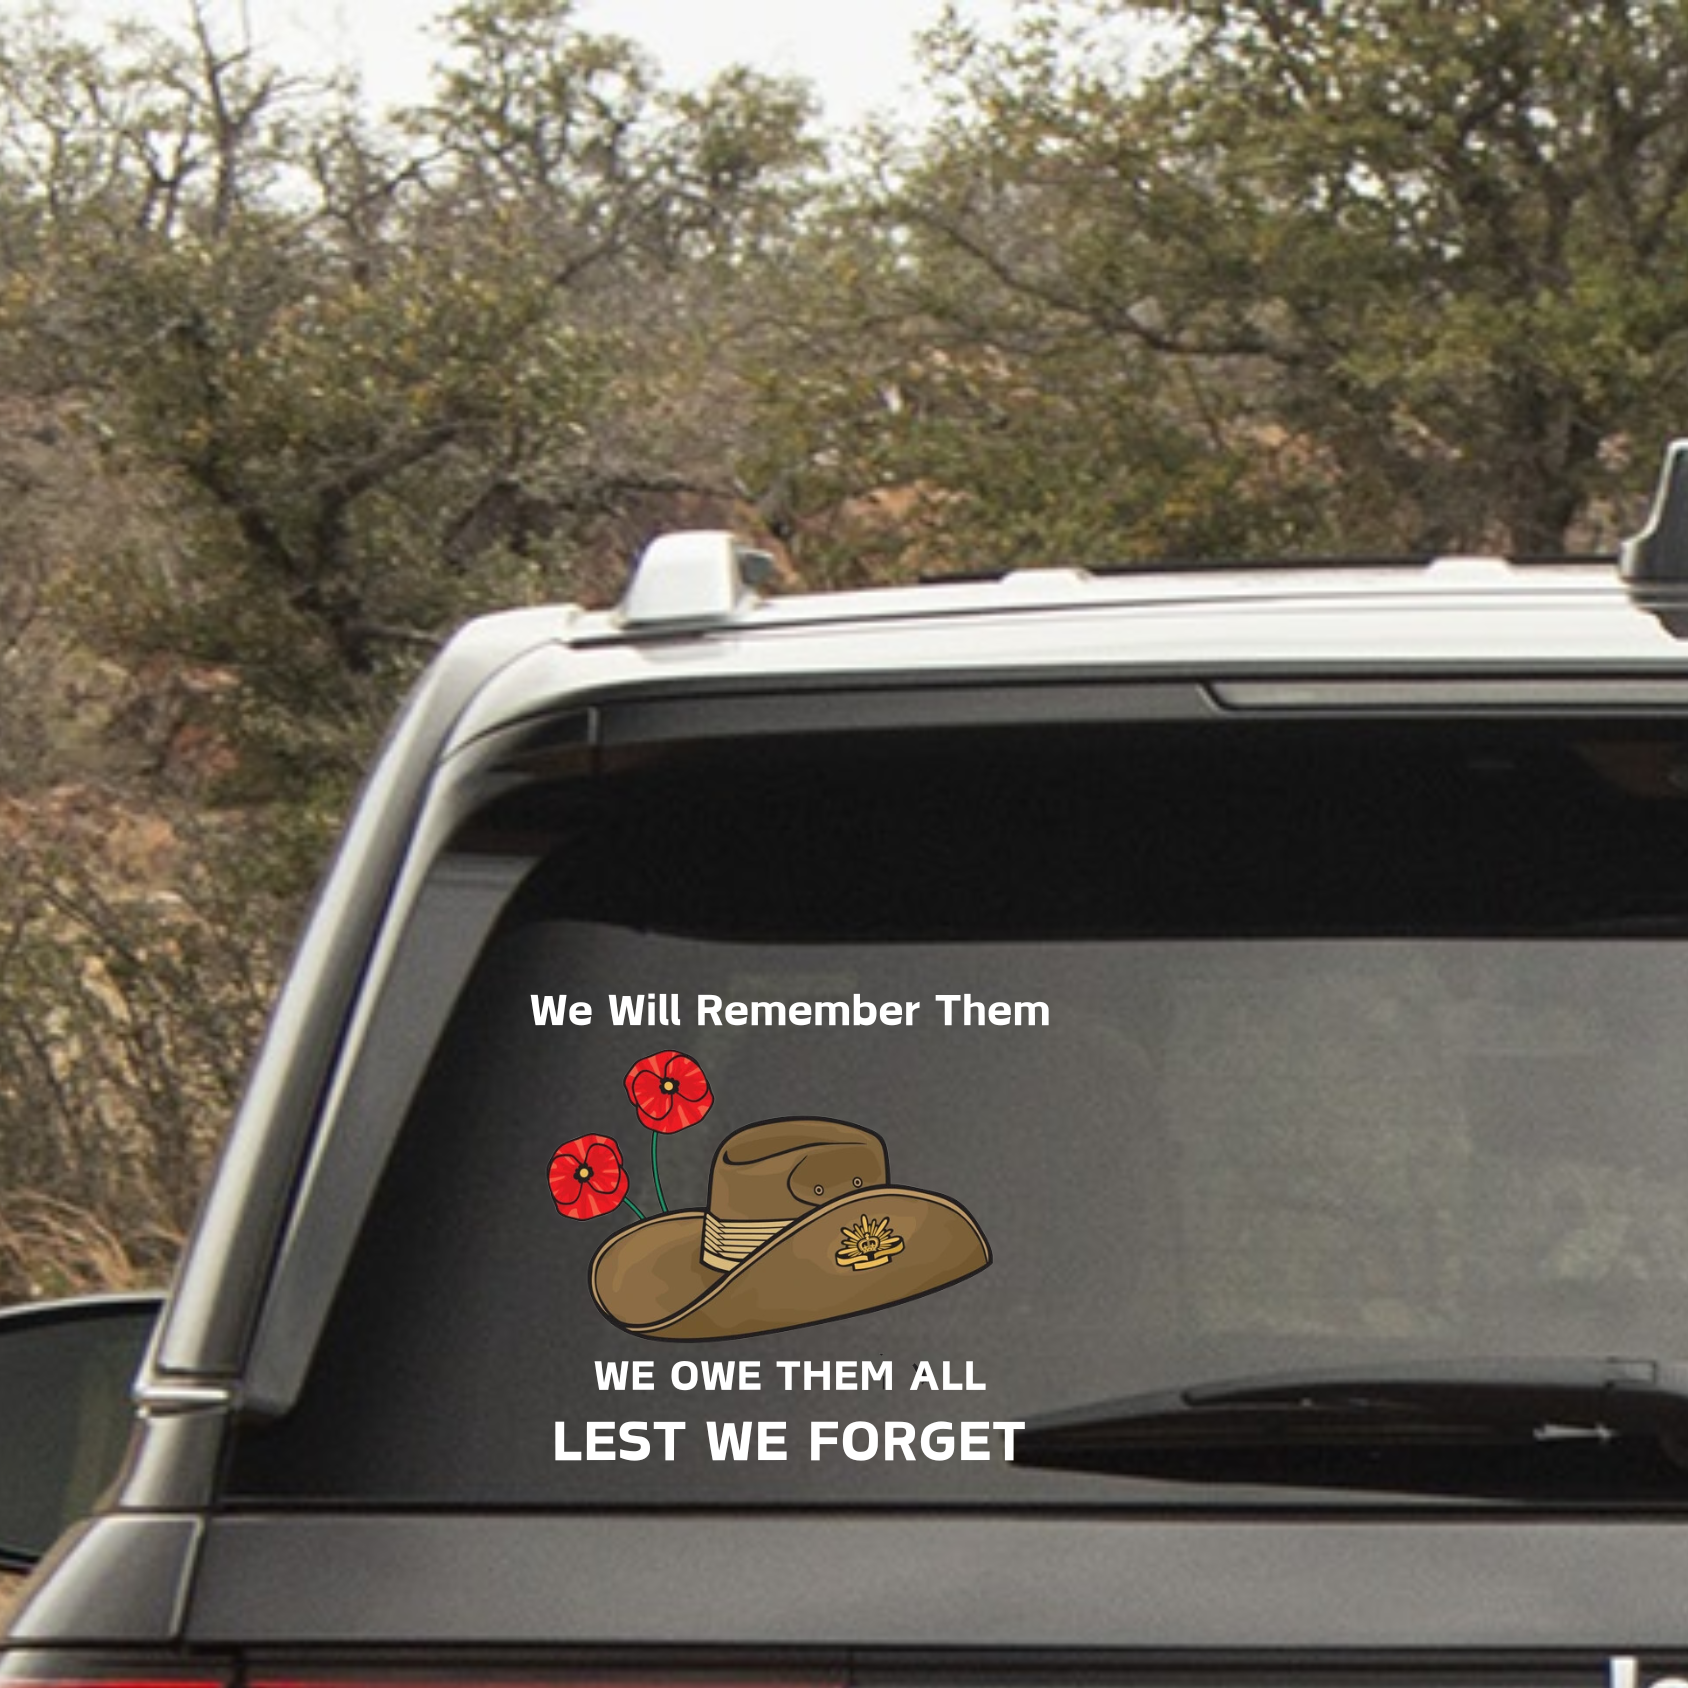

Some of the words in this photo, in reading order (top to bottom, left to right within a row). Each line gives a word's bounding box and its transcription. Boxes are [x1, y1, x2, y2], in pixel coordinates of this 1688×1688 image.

[530, 994, 592, 1026] We
[608, 993, 681, 1026] Will
[697, 993, 921, 1026] Remember
[935, 993, 1050, 1026] Them
[594, 1360, 655, 1391] WE
[671, 1360, 761, 1391] OWE
[776, 1360, 893, 1391] THEM
[909, 1360, 986, 1391] ALL
[554, 1421, 686, 1462] LEST
[706, 1421, 788, 1461] WE
[810, 1420, 1026, 1462] FORGET
